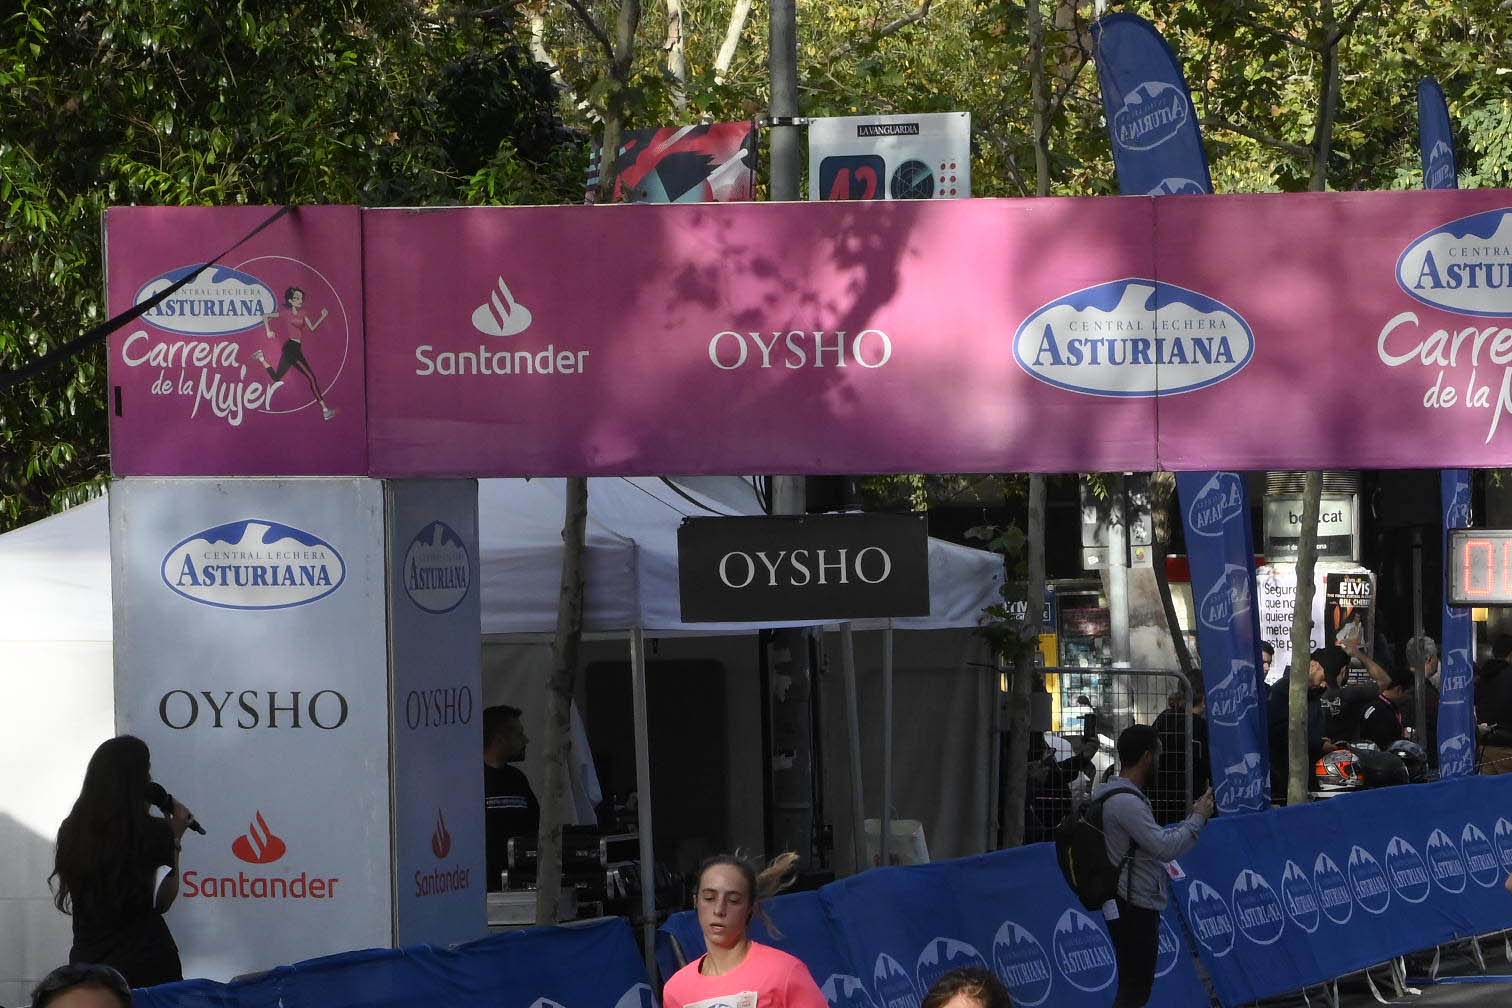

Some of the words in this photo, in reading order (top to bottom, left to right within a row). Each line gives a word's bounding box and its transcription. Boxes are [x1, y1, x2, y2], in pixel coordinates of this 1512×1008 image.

[144, 290, 266, 317] ASTURIANA
[173, 288, 212, 297] ENTRAL
[1069, 319, 1148, 331] CENTRAL
[1153, 318, 1228, 330] LECHERA
[122, 331, 240, 367] Carrera
[415, 343, 589, 376] Santander
[708, 329, 893, 370] OYSHO
[1032, 323, 1237, 367] ASTURIANA
[151, 370, 174, 395] de
[178, 369, 194, 395] la
[191, 365, 284, 426] Mujer
[1423, 370, 1458, 408] de
[1466, 369, 1490, 408] la
[1288, 509, 1343, 525] b.cat
[176, 552, 333, 587] ASTURIANA
[203, 551, 261, 560] CENTRAL
[265, 550, 328, 560] LECHERA
[717, 545, 893, 590] OYSHO
[409, 559, 467, 593] ASTURIANA
[1339, 582, 1370, 595] ELVIS
[1265, 600, 1282, 610] que
[157, 689, 350, 731] OYSHO
[405, 684, 473, 731] OYSHO
[181, 869, 339, 900] Santander
[414, 866, 470, 898] Santander
[1000, 958, 1048, 989] ASTURIANA
